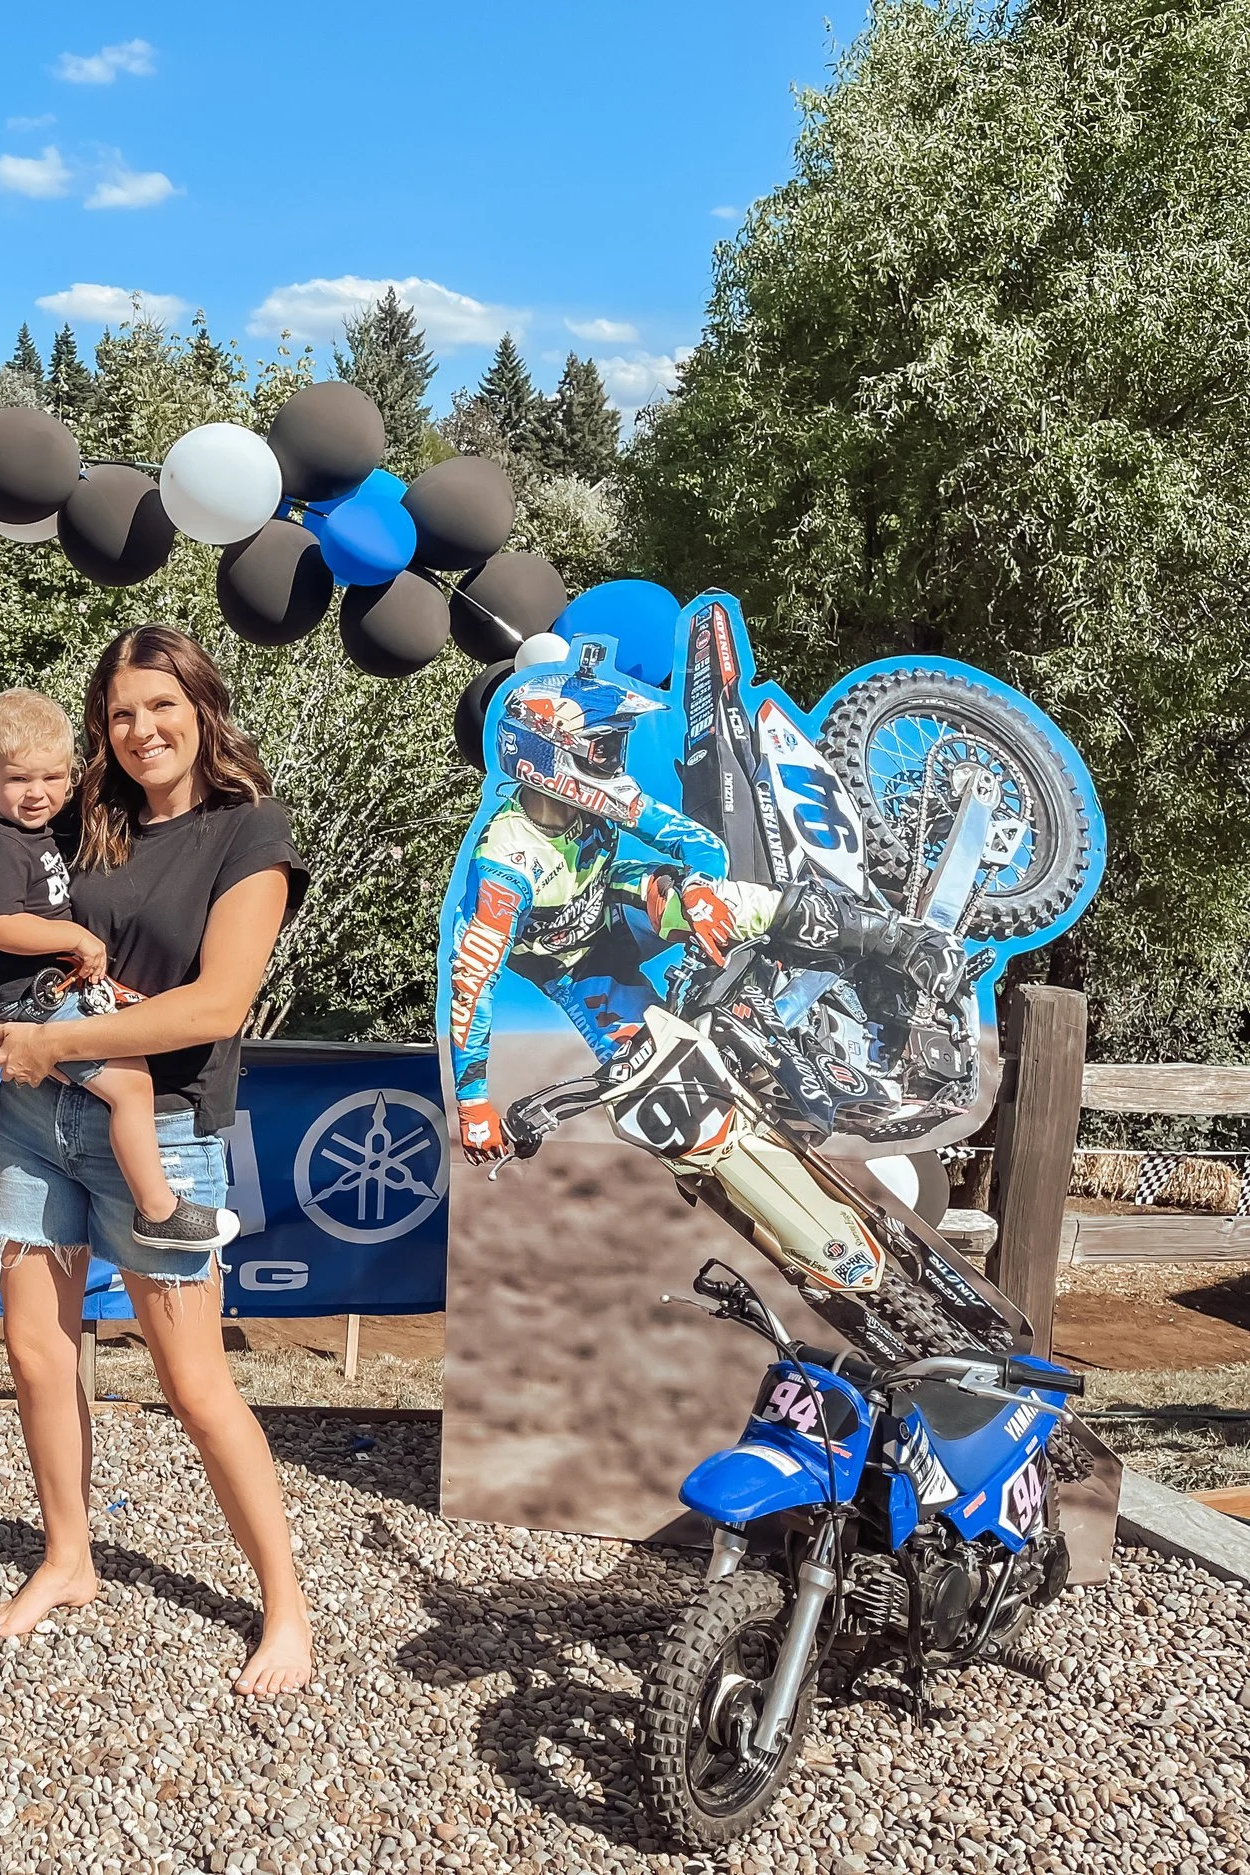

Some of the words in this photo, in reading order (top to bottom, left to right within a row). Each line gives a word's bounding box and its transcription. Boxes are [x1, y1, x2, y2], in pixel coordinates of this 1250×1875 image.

[715, 610, 732, 673] DUNLOP
[727, 707, 748, 740] RCH
[723, 772, 734, 813] SUZUKI
[776, 762, 859, 854] 94
[765, 828, 790, 883] FREAKY
[636, 1044, 733, 1160] 94
[761, 1380, 825, 1433] 94
[1012, 1462, 1043, 1534] 94
